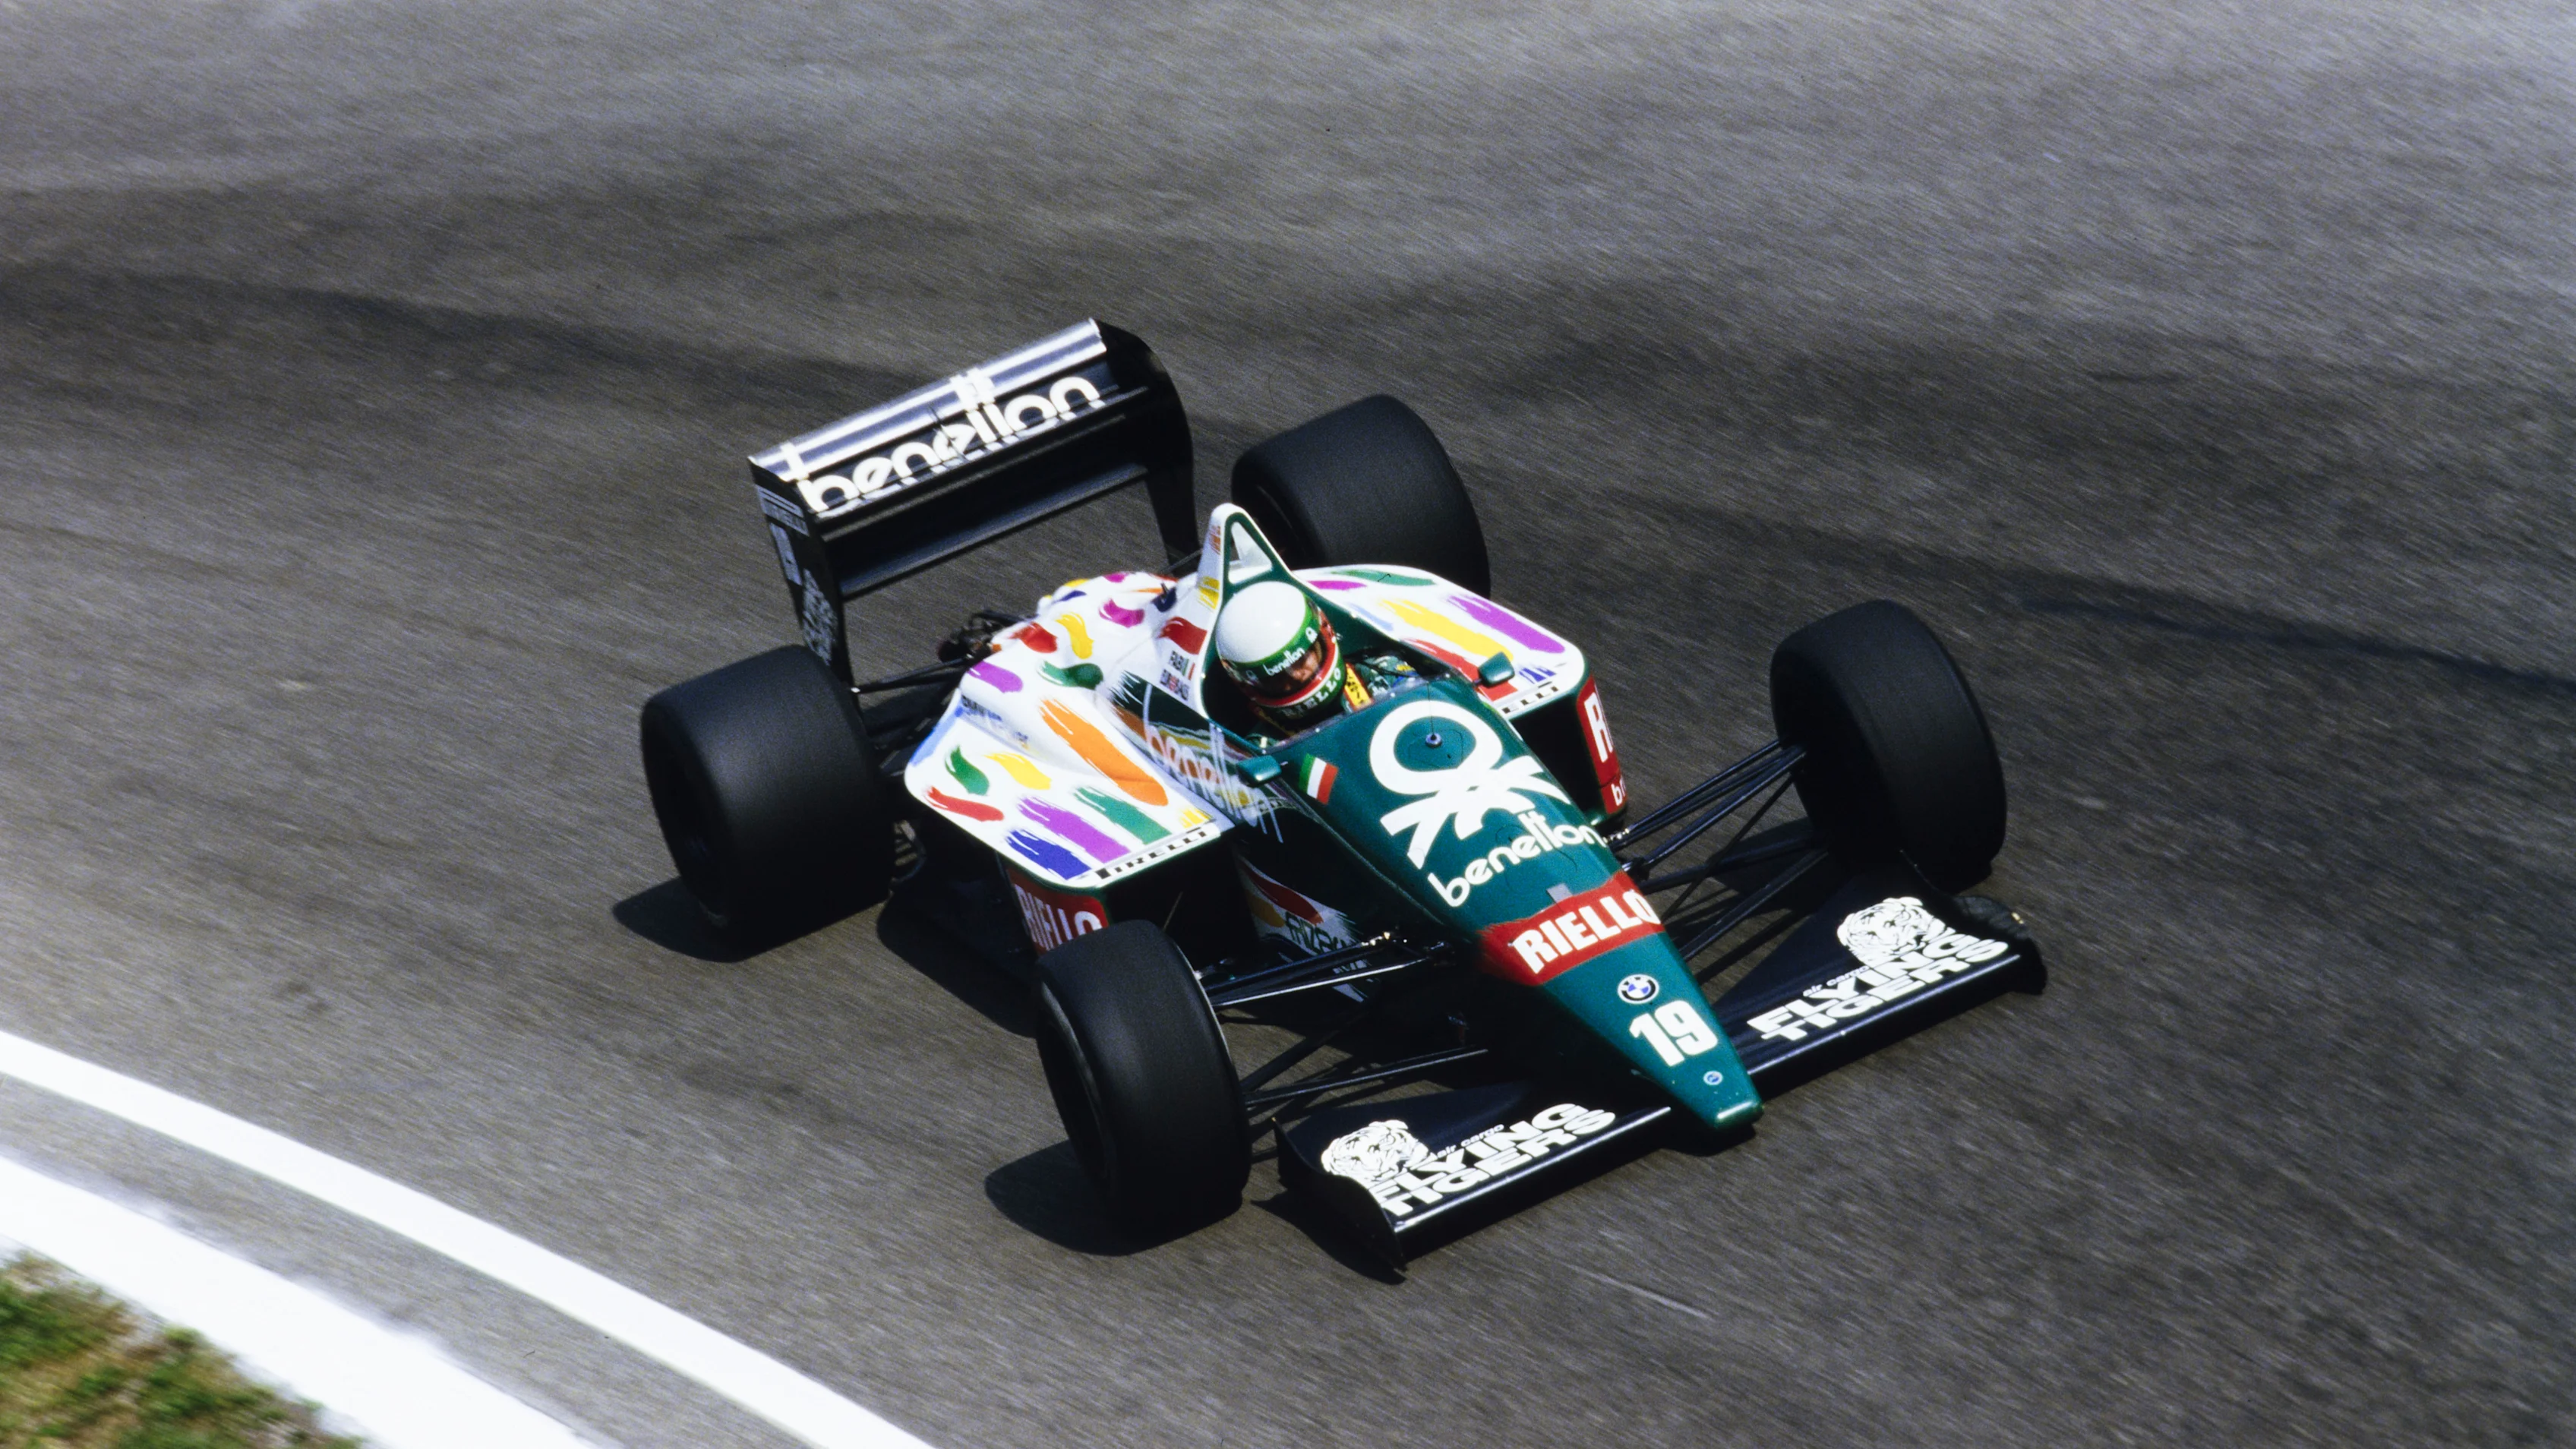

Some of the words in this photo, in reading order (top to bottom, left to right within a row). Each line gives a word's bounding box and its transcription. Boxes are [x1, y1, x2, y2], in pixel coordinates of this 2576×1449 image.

[780, 367, 1106, 519] benetton
[1263, 646, 1305, 676] benetton
[1428, 810, 1608, 908] benetton
[1513, 889, 1661, 974] RIELLO
[1747, 933, 1981, 1034] FLYING
[1761, 939, 2009, 1041] TIGERS
[1629, 1000, 1719, 1067] 19
[1369, 1103, 1589, 1204] FLYING
[1380, 1109, 1616, 1217] TIGERS
[1460, 1124, 1504, 1147] cargo
